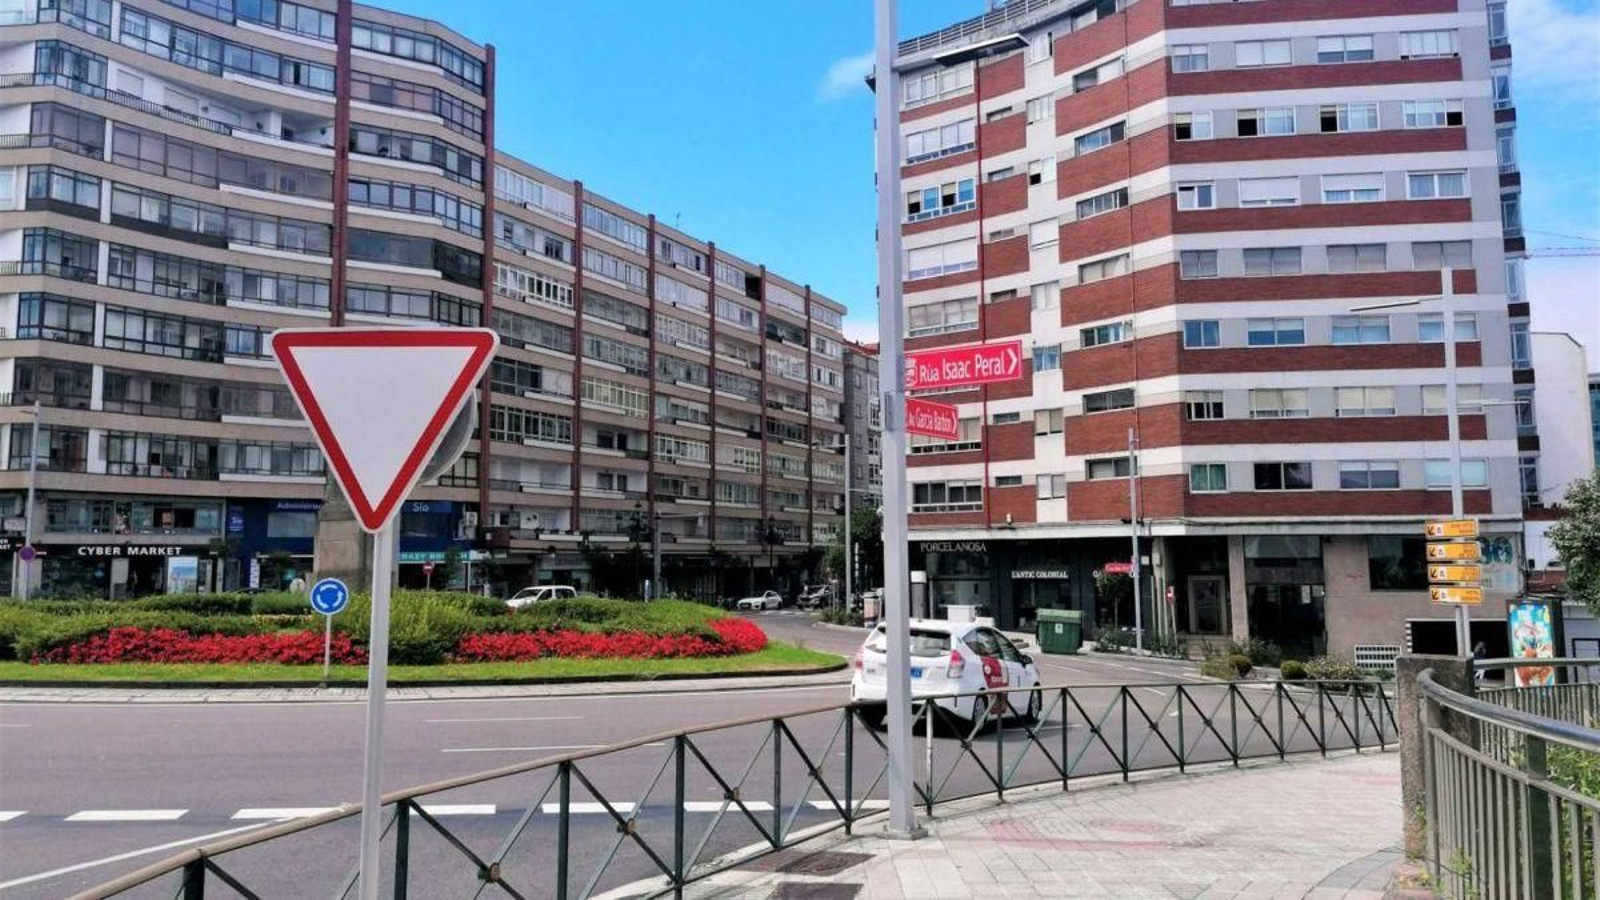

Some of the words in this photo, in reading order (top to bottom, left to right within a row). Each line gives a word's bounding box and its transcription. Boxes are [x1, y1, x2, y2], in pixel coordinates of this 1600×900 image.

[920, 364, 939, 382] Rúa
[942, 358, 971, 380] Isaac
[975, 351, 1006, 377] Peral
[78, 546, 121, 556] CYBER
[127, 546, 182, 556] MARKET
[920, 542, 987, 552] PORCELANOSA
